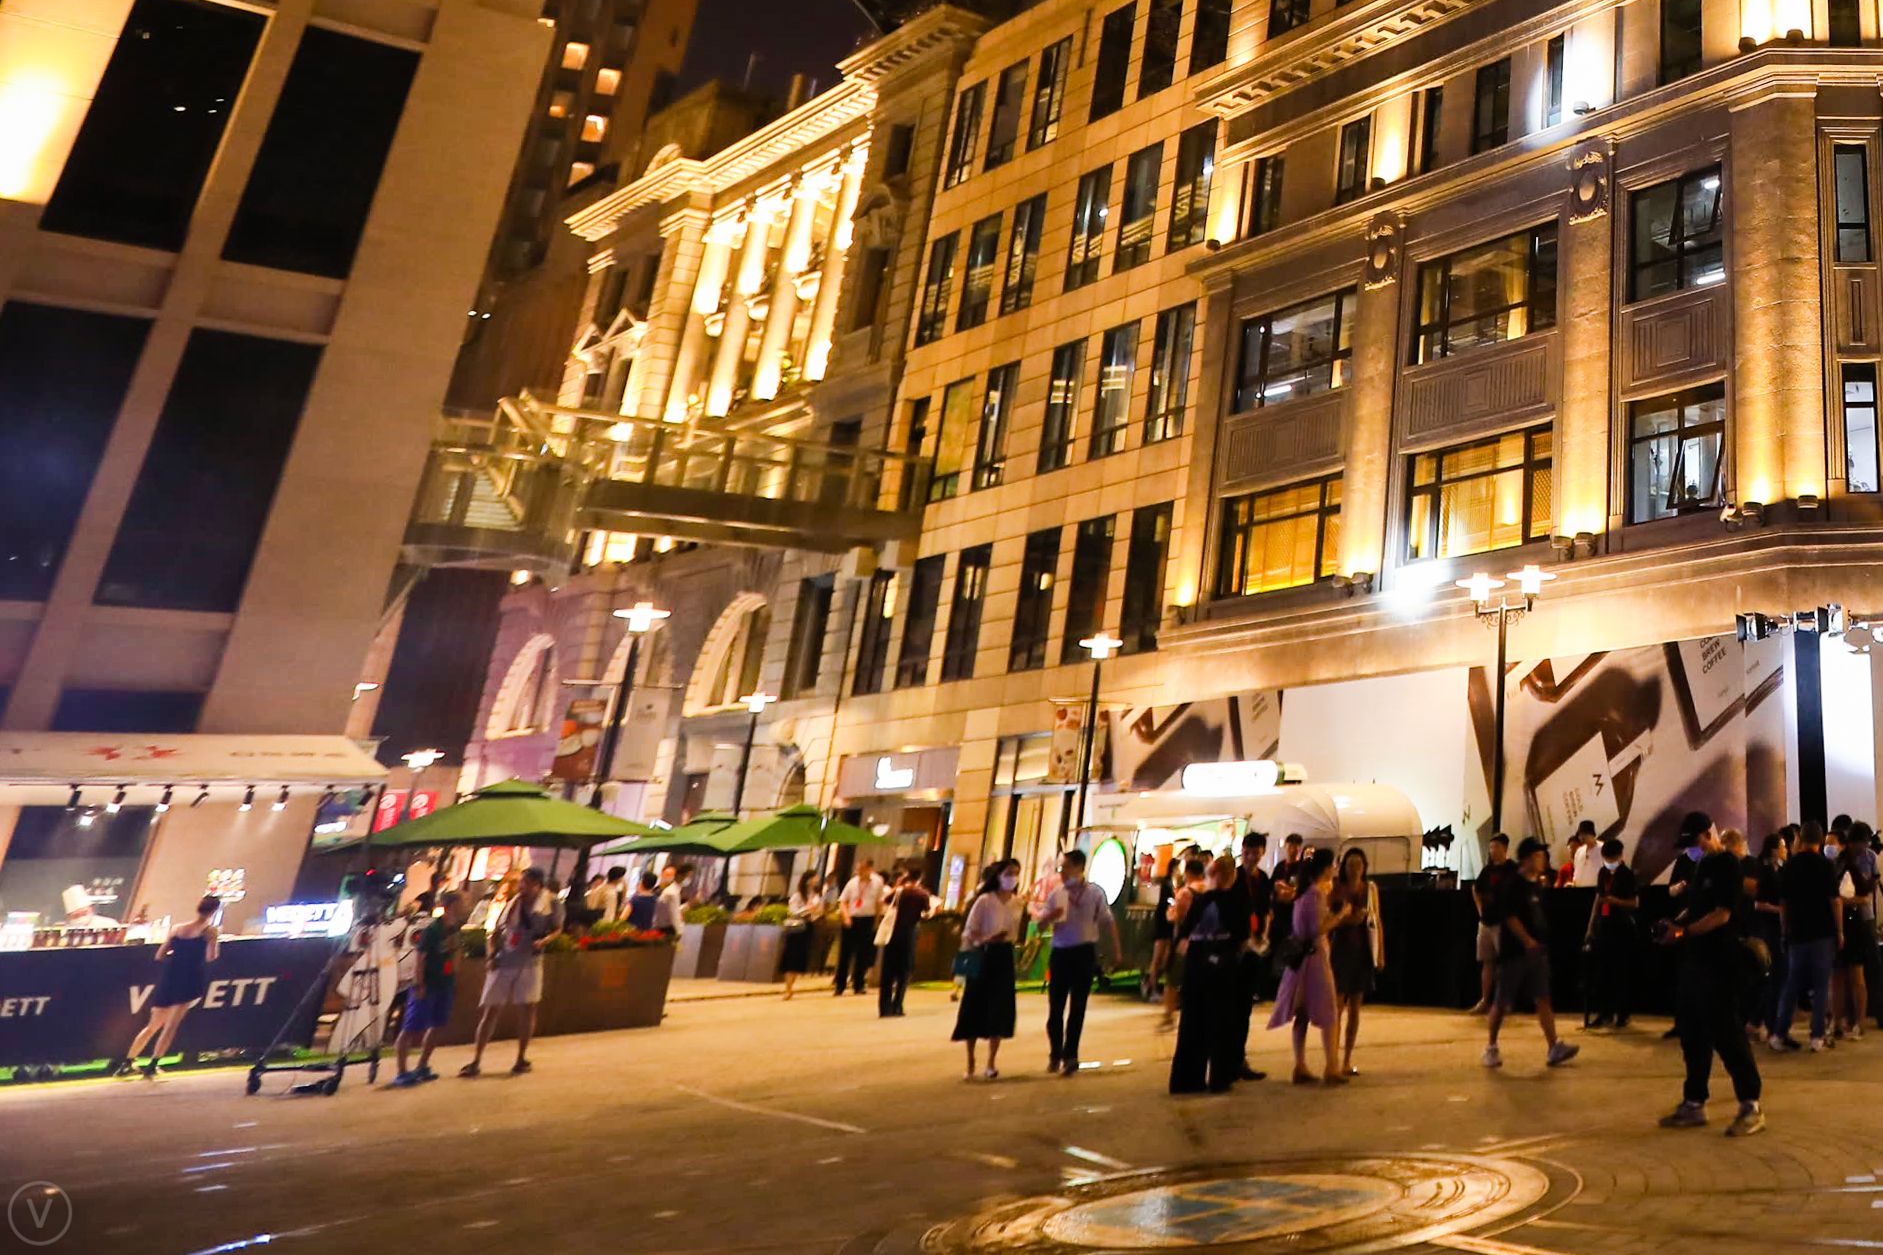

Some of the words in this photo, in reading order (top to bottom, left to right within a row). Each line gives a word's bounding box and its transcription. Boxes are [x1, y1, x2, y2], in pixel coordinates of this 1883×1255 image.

[1702, 638, 1721, 661] BREW
[1702, 647, 1727, 674] COFFEE
[129, 977, 277, 1014] VETT
